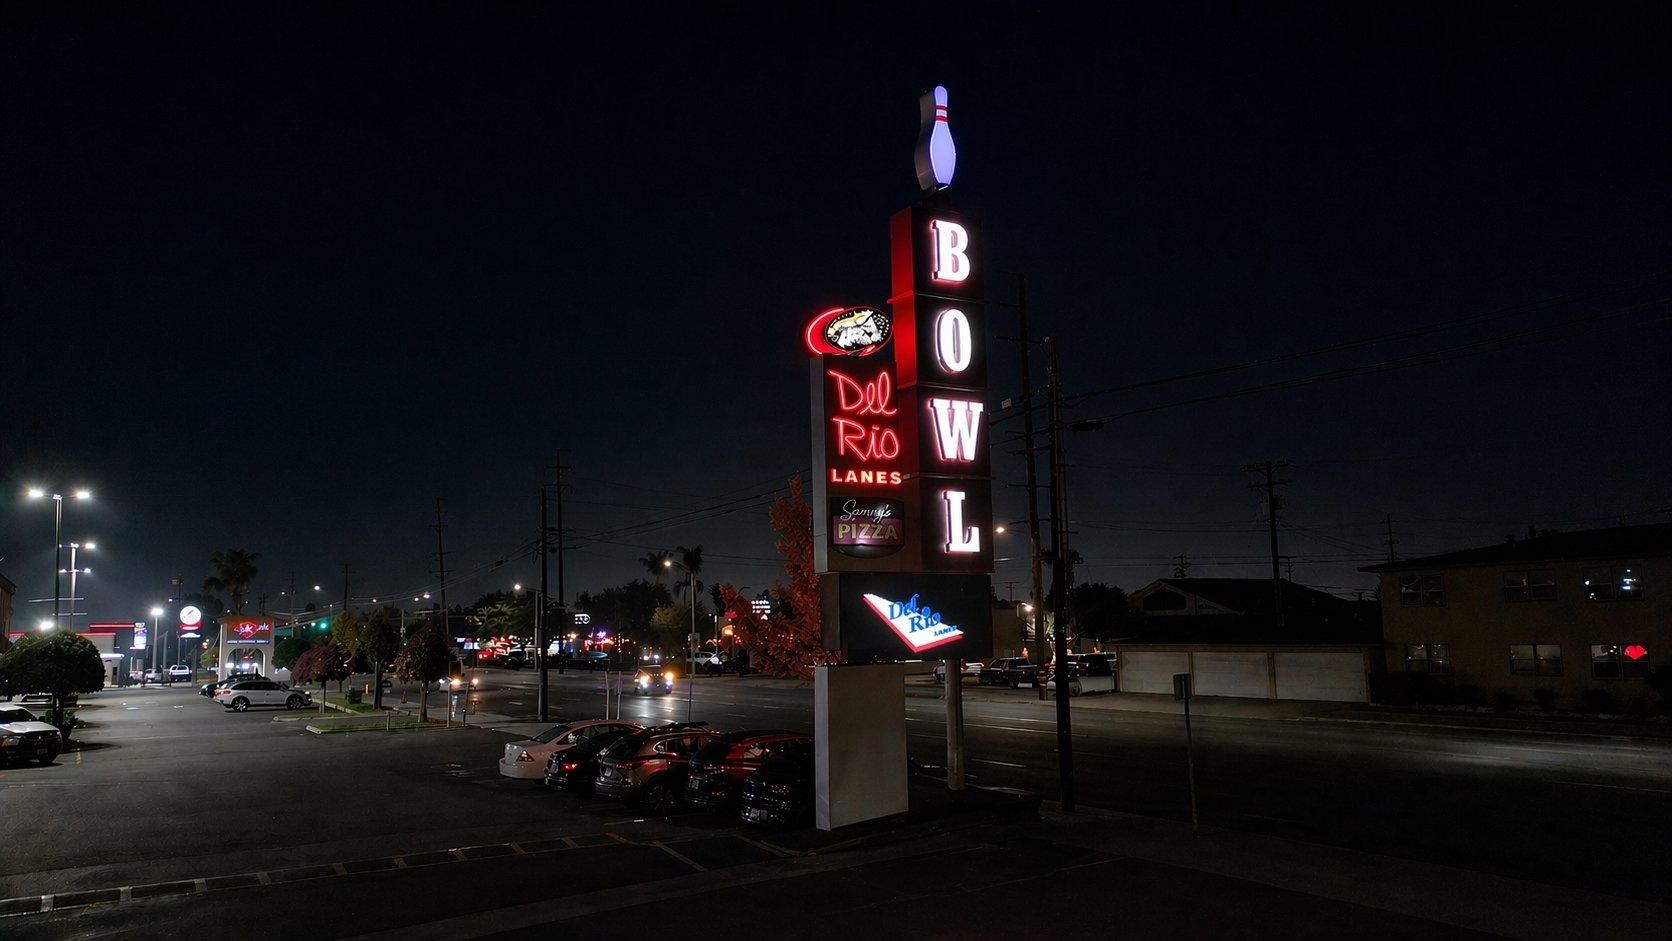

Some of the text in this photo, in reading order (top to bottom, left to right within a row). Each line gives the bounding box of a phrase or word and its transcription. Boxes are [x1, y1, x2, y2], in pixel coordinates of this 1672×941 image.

[827, 369, 898, 415] Del
[931, 219, 984, 554] BOWL
[831, 416, 900, 461] Rio
[831, 468, 902, 485] LANES
[838, 523, 898, 540] PIZZA
[888, 594, 920, 620] Del
[909, 606, 941, 633] Rio
